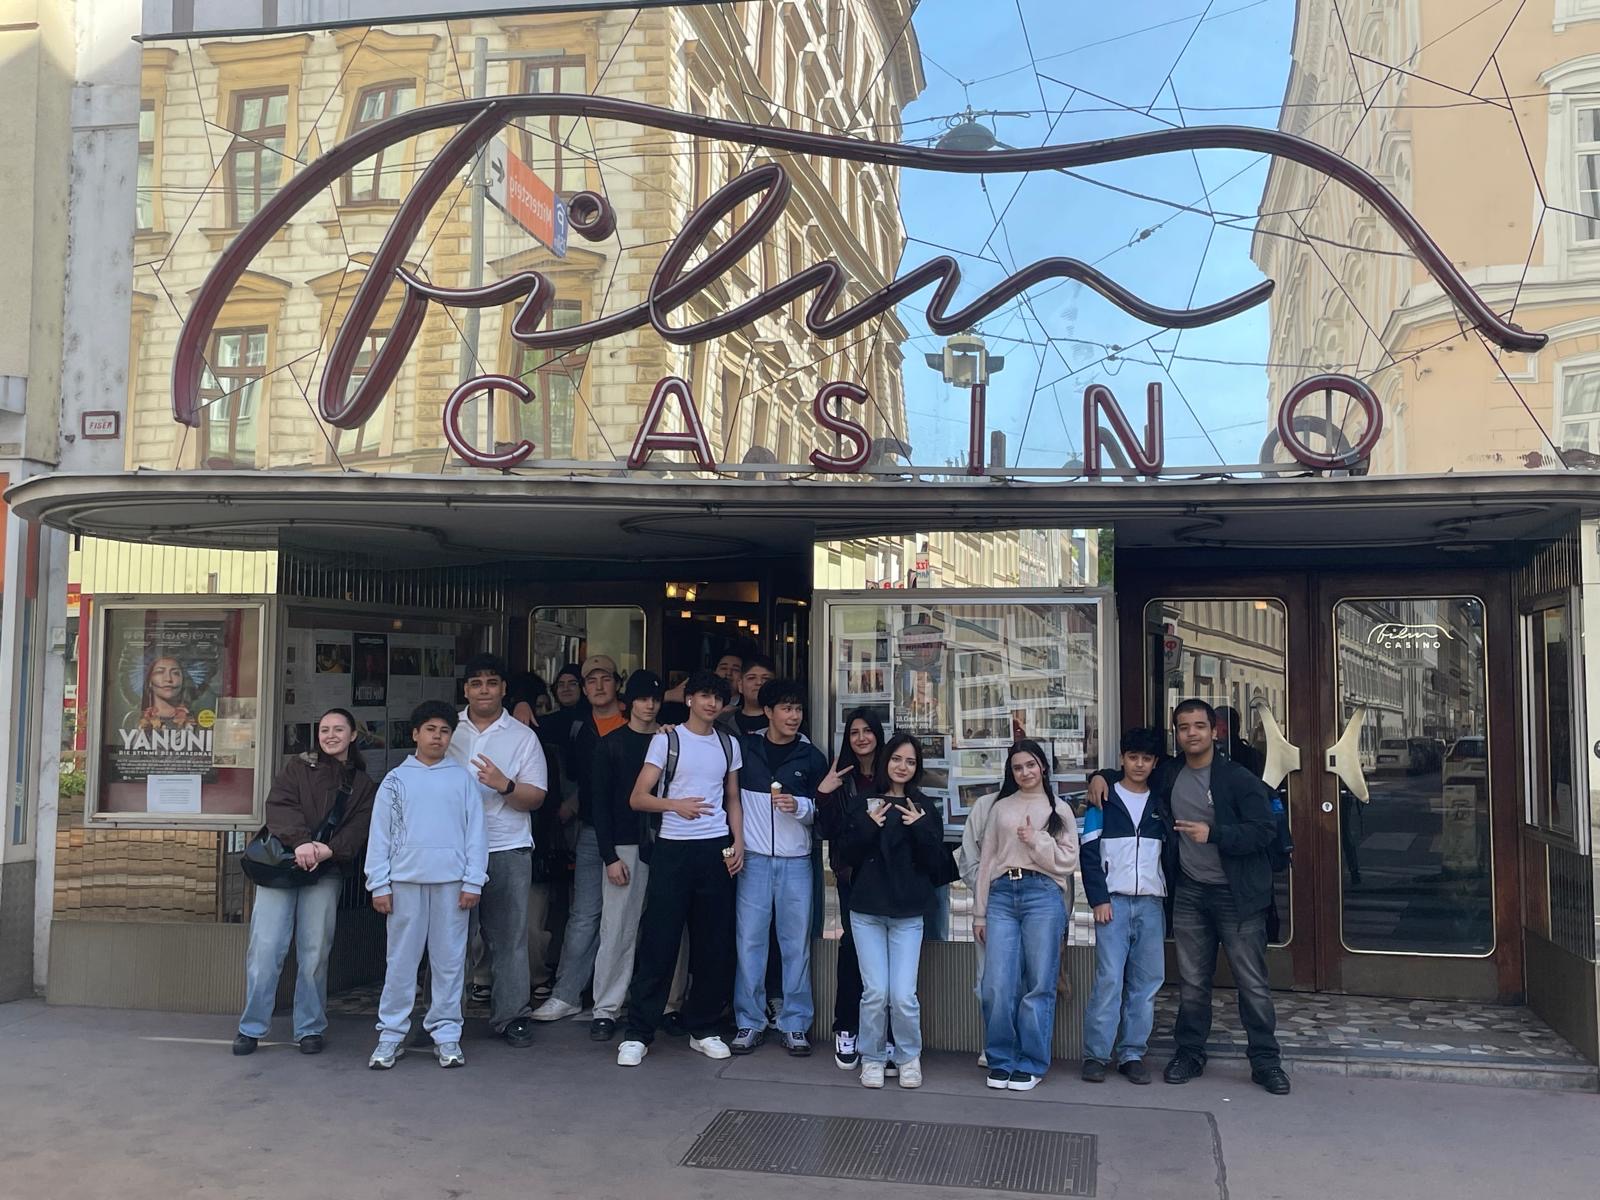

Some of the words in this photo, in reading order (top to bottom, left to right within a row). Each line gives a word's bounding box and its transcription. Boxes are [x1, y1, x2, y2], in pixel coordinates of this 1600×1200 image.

[443, 373, 1382, 473] CASINO
[119, 729, 213, 751] YANUNI
[175, 750, 213, 758] AMAZONAS
